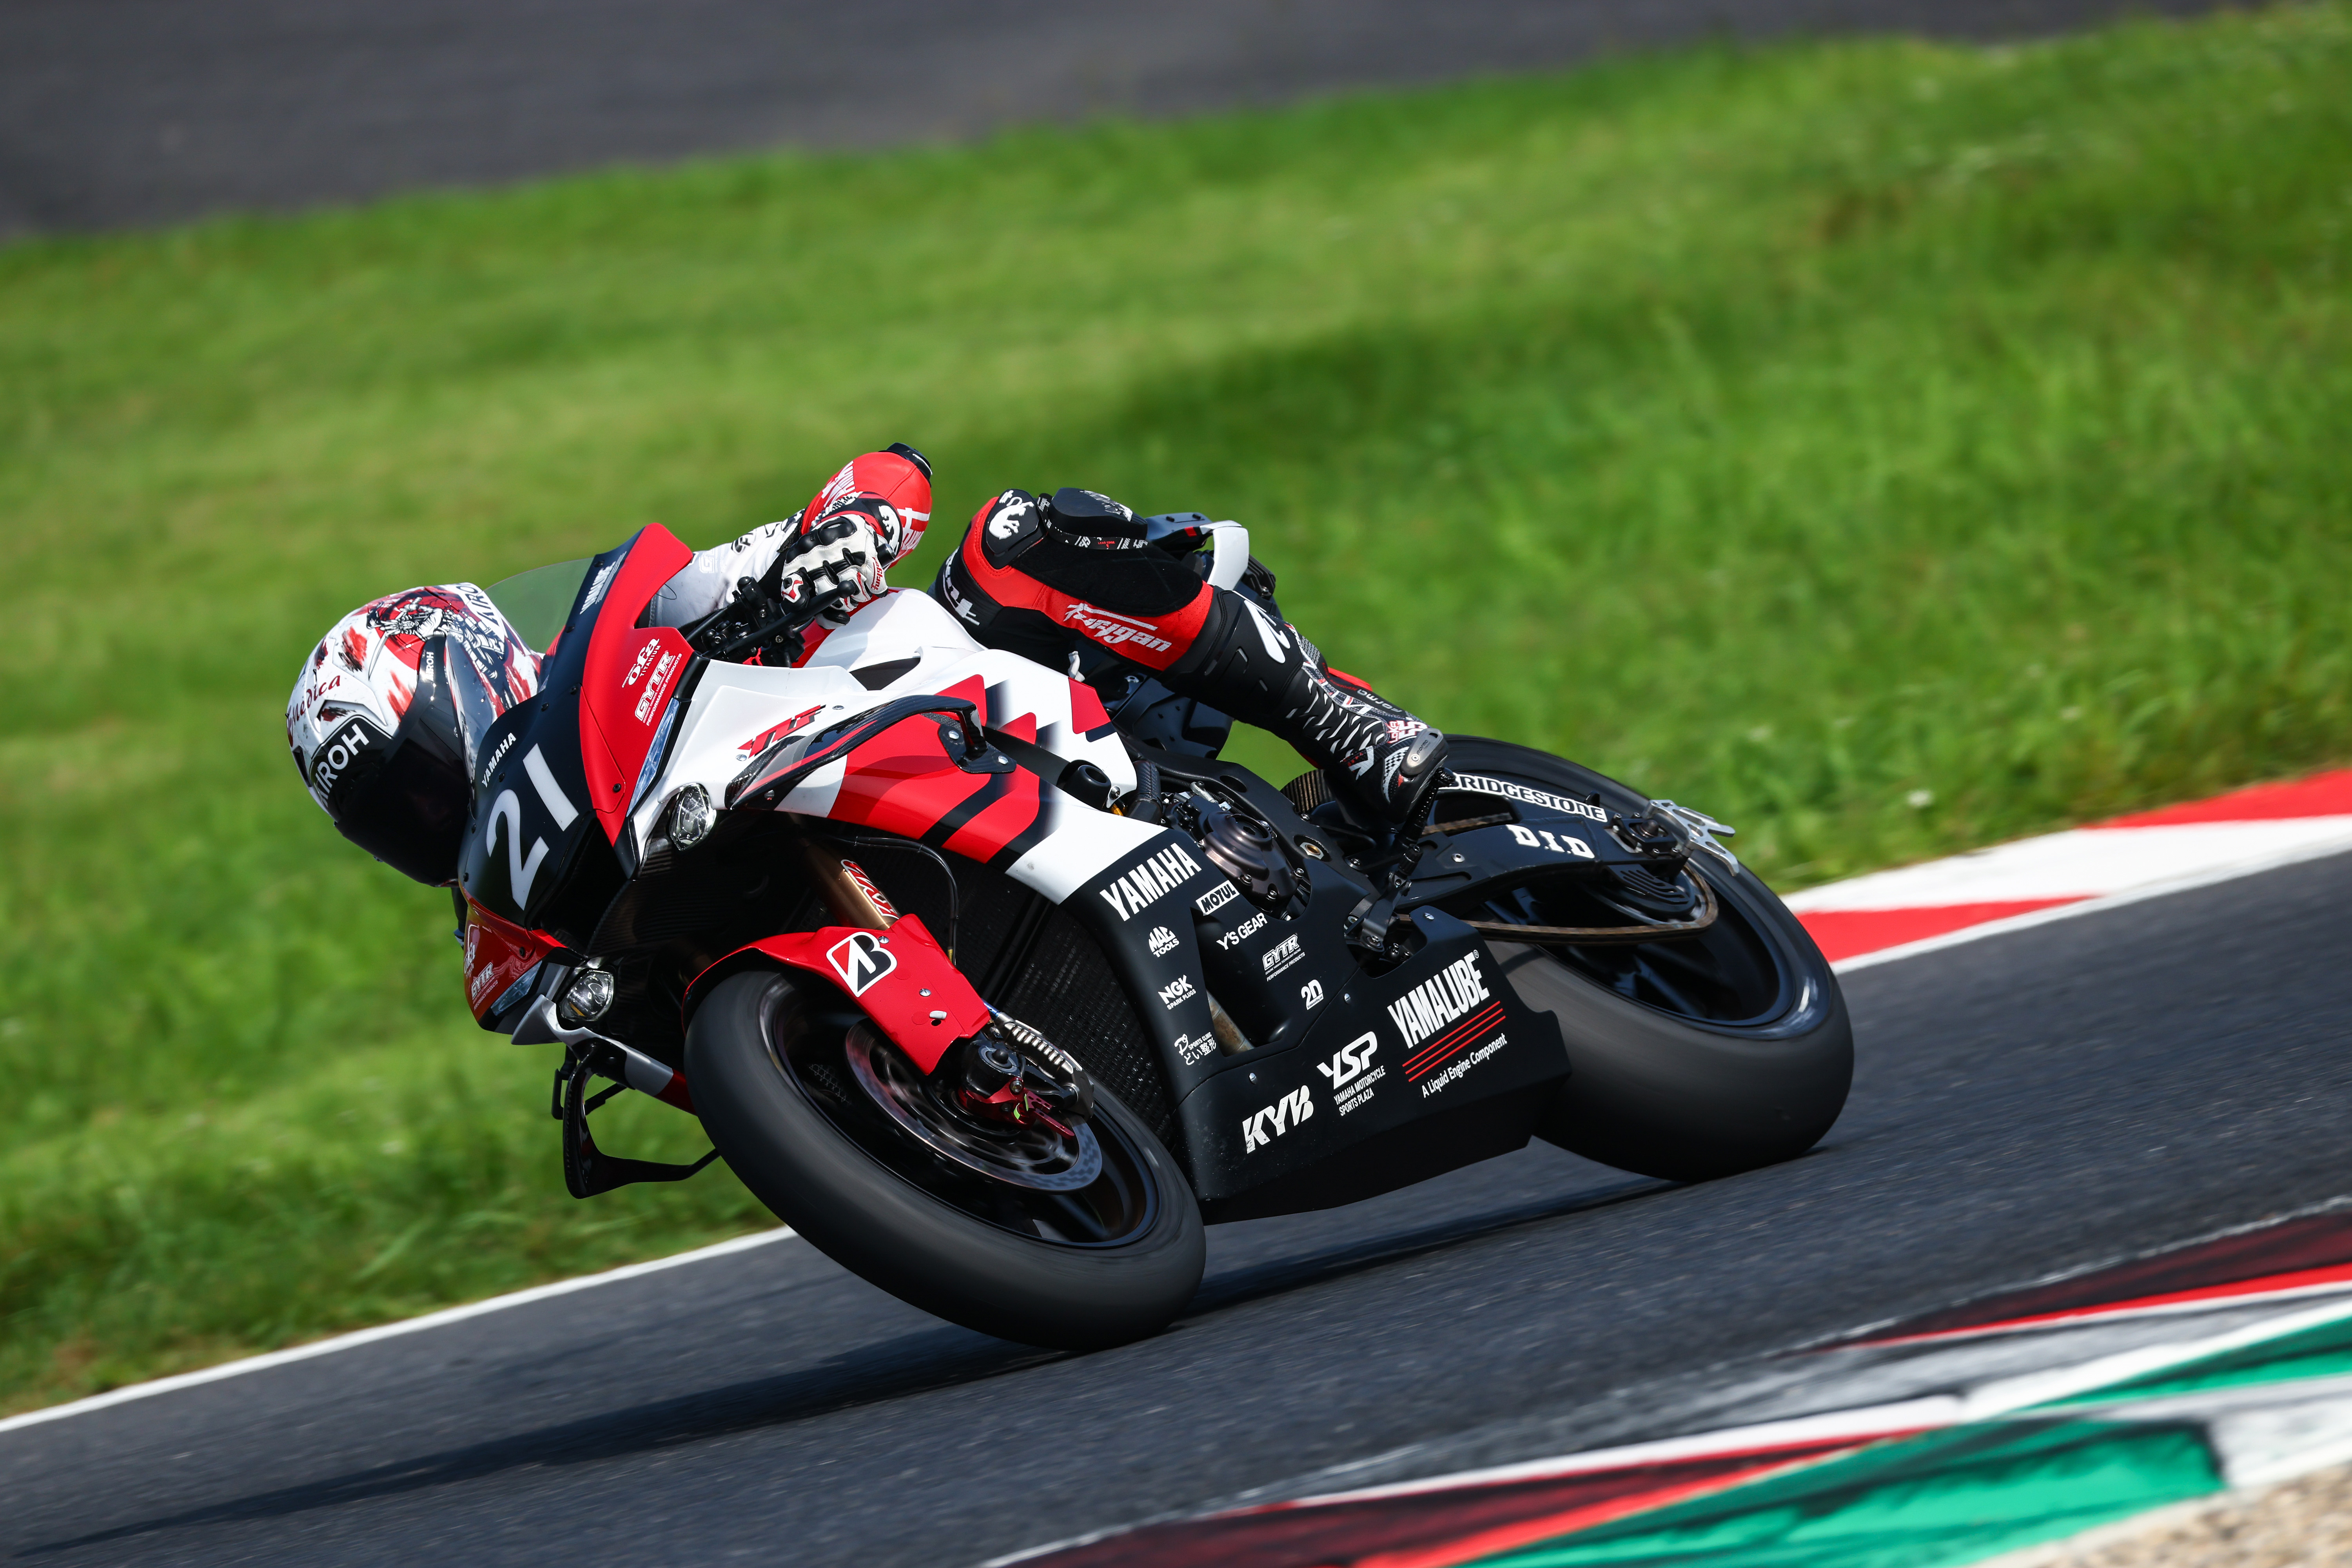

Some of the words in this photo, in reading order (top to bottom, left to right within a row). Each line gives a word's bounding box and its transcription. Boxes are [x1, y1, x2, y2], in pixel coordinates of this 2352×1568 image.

[640, 645, 661, 677] TITANIUM
[656, 668, 669, 692] TECHNOLOGY
[668, 655, 676, 669] RACING
[635, 652, 673, 721] GYTR
[646, 683, 667, 726] PERFORMANCE
[665, 653, 682, 683] PRODUCTS
[481, 732, 516, 788] YAMAHA
[486, 743, 579, 911] 21
[1100, 843, 1201, 921] YAMAHA
[1201, 885, 1236, 913] MOTUL
[1149, 926, 1176, 952] MAC
[1153, 938, 1180, 958] TOOLS
[1216, 931, 1239, 950] Y'S
[1238, 913, 1267, 939] GEAR
[1263, 934, 1299, 971] GYTR
[1267, 963, 1289, 982] PERFORMANCE
[1289, 952, 1305, 966] PRODUCTS
[1281, 954, 1294, 964] TECHNOLOGY
[471, 962, 494, 1000] GYTR
[474, 992, 487, 1011] PERFORMANCE
[486, 980, 498, 995] PRODUCTS
[1158, 975, 1192, 1004] NGK
[1301, 979, 1324, 1010] 2D
[1167, 996, 1183, 1010] SPARK
[1182, 989, 1196, 1000] PLUGS
[1387, 952, 1490, 1049] YAMALUBE
[1184, 1037, 1216, 1065] どい整形
[1188, 1038, 1203, 1050] SPORTS
[1201, 1032, 1212, 1041] CLINIC
[1422, 1085, 1429, 1098] A
[1429, 1073, 1450, 1097] Liquid
[1448, 1060, 1472, 1082] Engine
[1469, 1033, 1508, 1066] Component
[1334, 1085, 1356, 1105] YAMAHA
[1354, 1065, 1386, 1093] MOTORCYCLE
[1339, 1097, 1360, 1116] SPORTS
[1357, 1087, 1374, 1107] PLAZA
[1242, 1085, 1314, 1154] KYB
